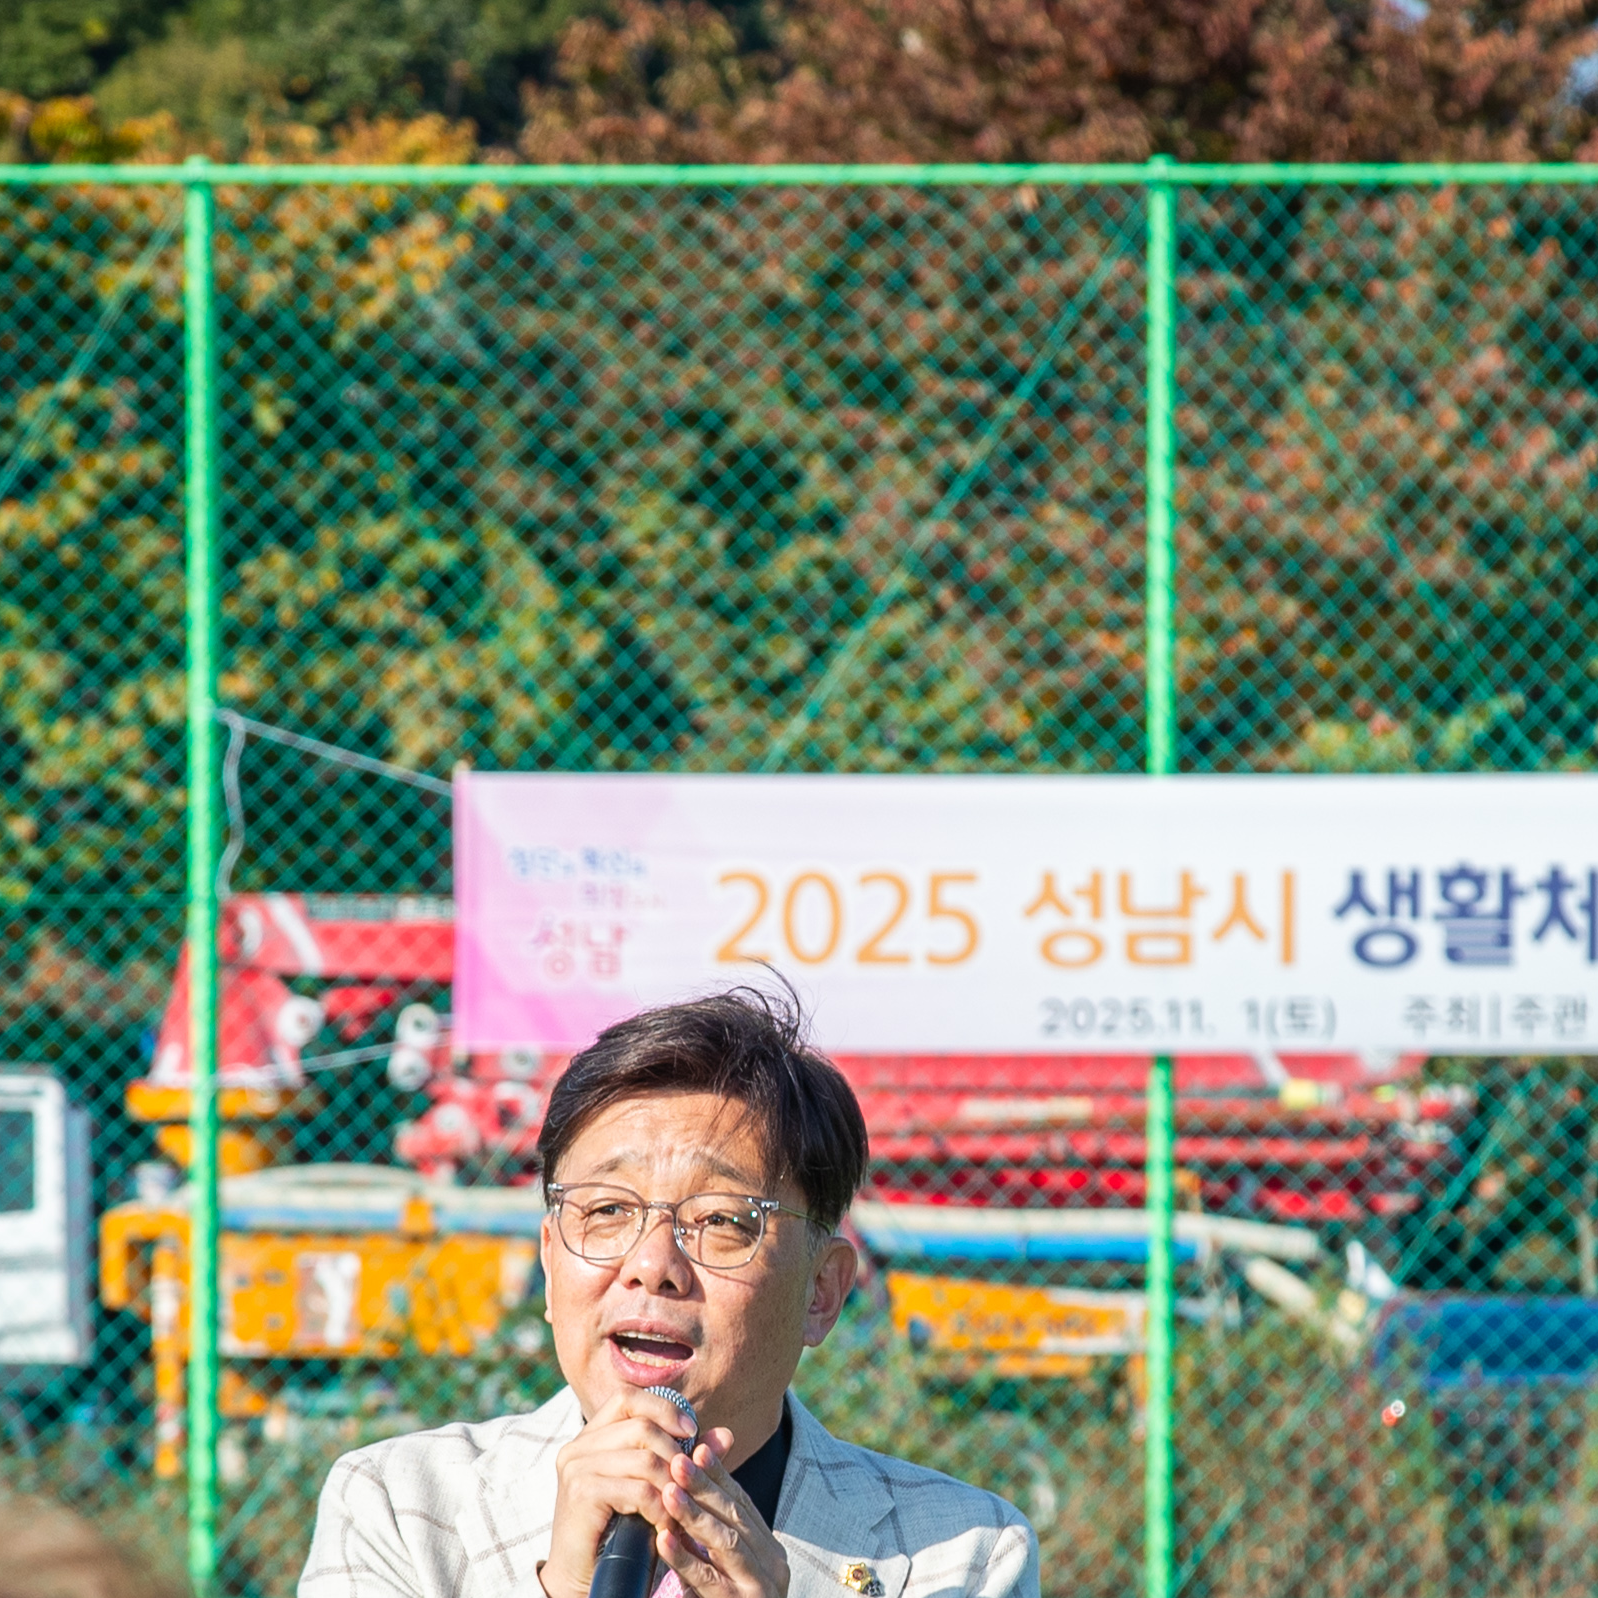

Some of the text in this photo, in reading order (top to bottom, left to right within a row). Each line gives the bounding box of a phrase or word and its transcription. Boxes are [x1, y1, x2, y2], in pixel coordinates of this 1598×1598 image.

[533, 917, 627, 980] 성남
[714, 870, 981, 967] 2025
[1024, 869, 1296, 969] 성남시
